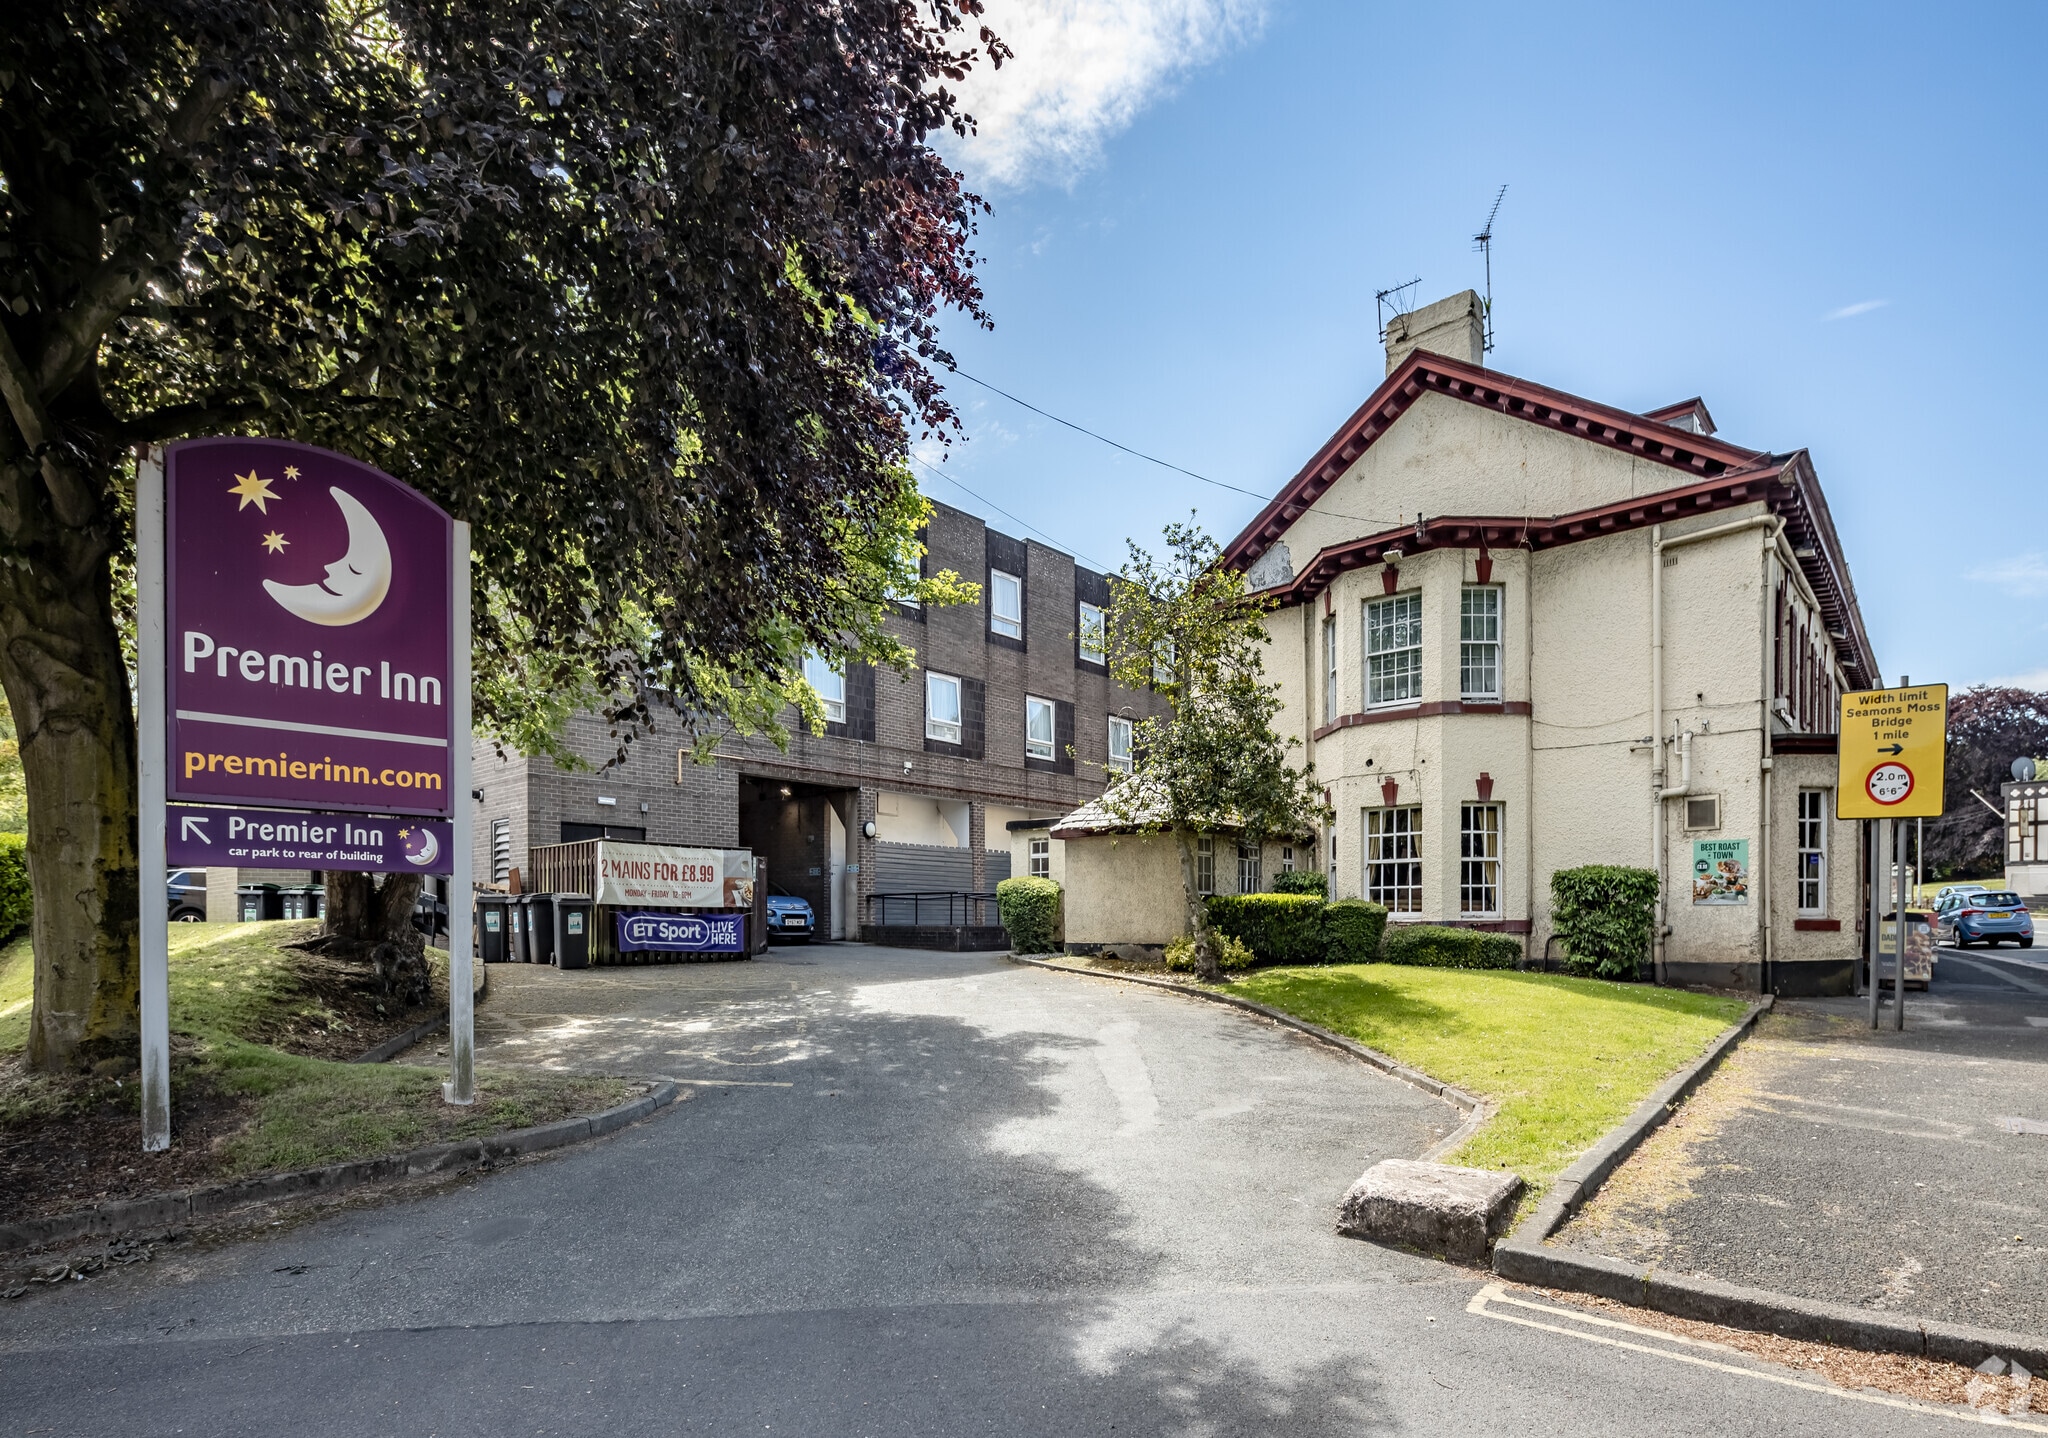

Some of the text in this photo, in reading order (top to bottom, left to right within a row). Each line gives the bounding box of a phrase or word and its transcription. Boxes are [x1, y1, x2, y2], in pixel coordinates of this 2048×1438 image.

[184, 631, 441, 705] Premier Inn
[1859, 691, 1928, 705] Width limit
[1846, 703, 1940, 718] Seamons Moss
[1872, 717, 1912, 727] Bridge
[1873, 730, 1909, 740] 1 mile
[185, 751, 442, 790] premierinn.com
[1876, 772, 1895, 781] 2.0
[228, 816, 383, 846] Premier Inn
[1700, 842, 1740, 851] BEST ROAST
[228, 848, 384, 864] car park to rear of building
[1713, 851, 1734, 859] TOWN
[601, 859, 714, 882] 2 MAINS FOR £8.99
[624, 888, 647, 898] MONDAY
[651, 889, 670, 898] FRIDAY
[658, 922, 701, 941] Sport
[711, 921, 734, 933] LIVE
[711, 933, 737, 945] HERE
